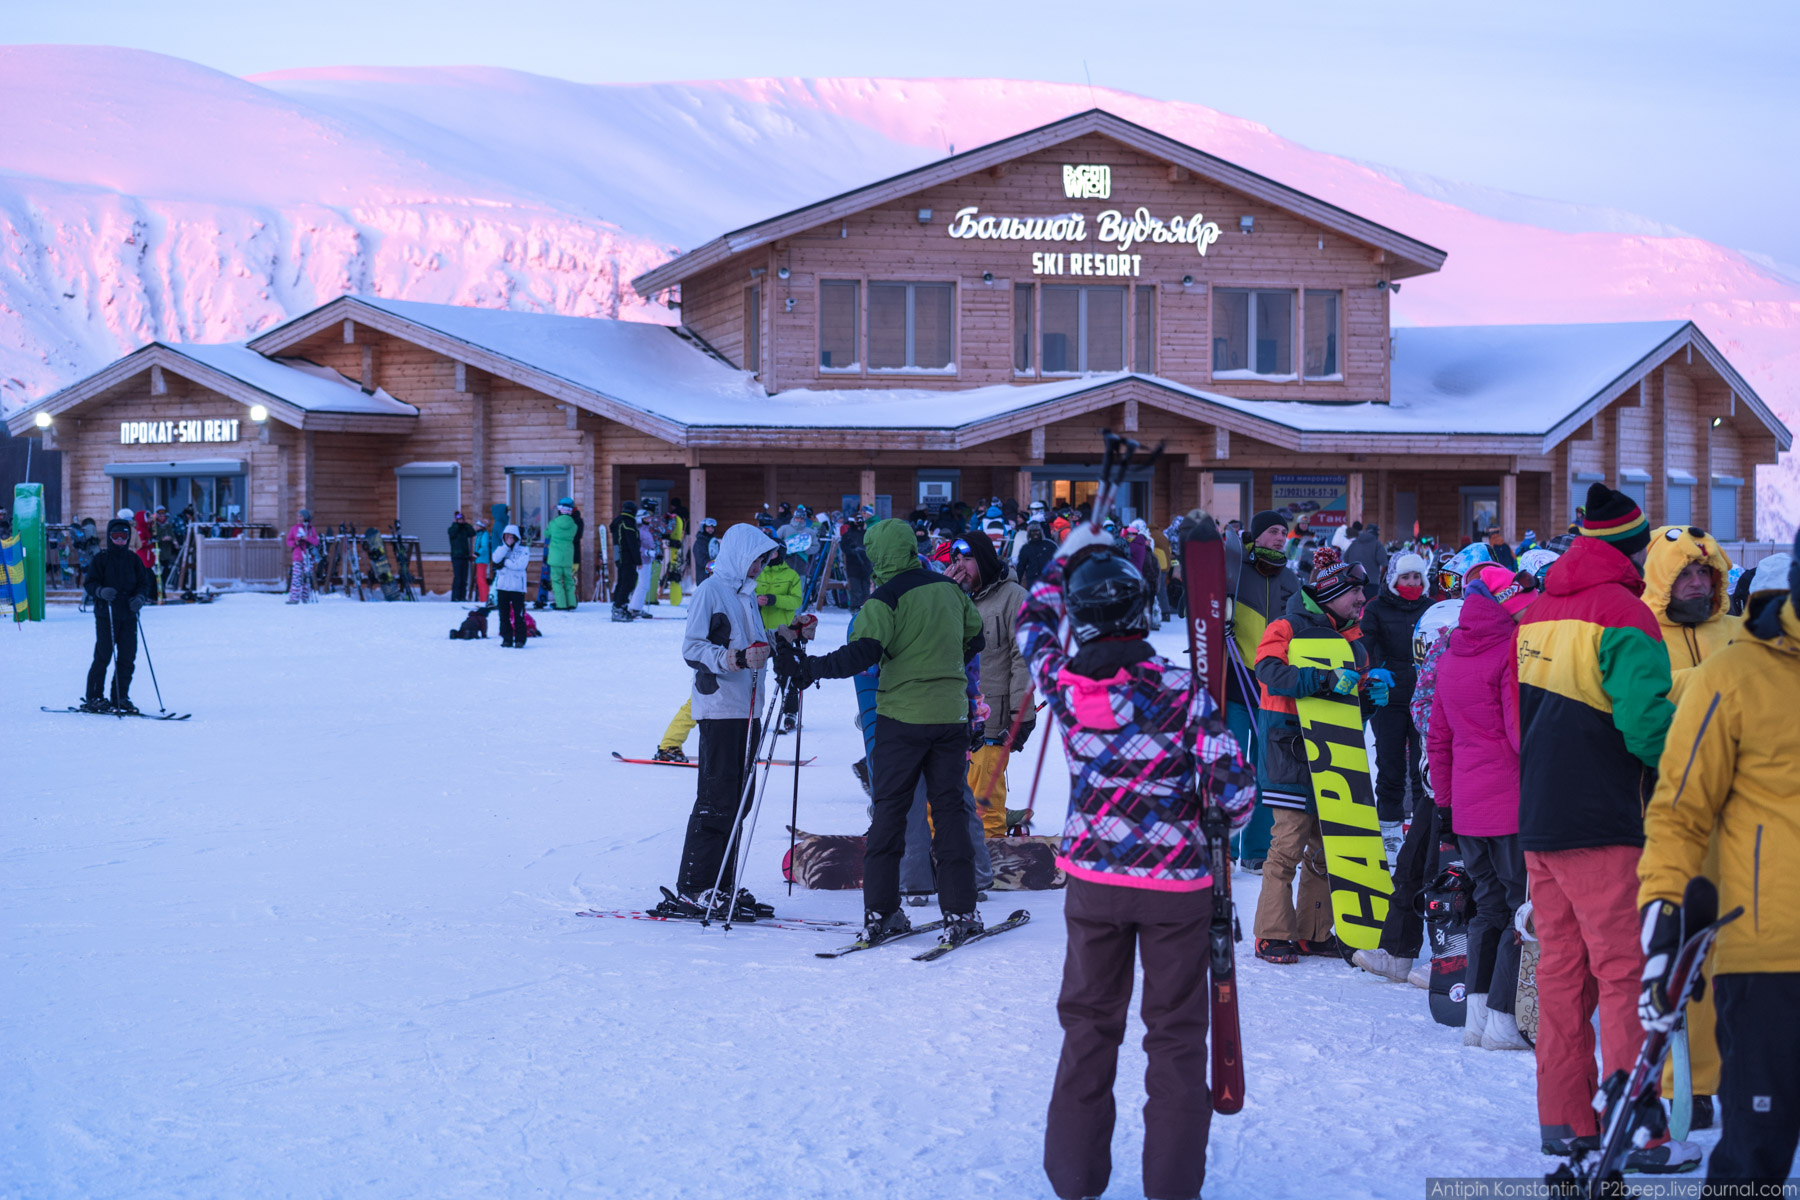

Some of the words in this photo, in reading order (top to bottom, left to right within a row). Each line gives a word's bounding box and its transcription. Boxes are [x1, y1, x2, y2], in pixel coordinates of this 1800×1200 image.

[948, 207, 1087, 241] Большой
[1097, 207, 1223, 257] Вудъявр
[1033, 252, 1063, 275] SKI
[1071, 253, 1142, 276] RESORT
[204, 419, 239, 442] RENT
[1195, 618, 1209, 688] TOMIC
